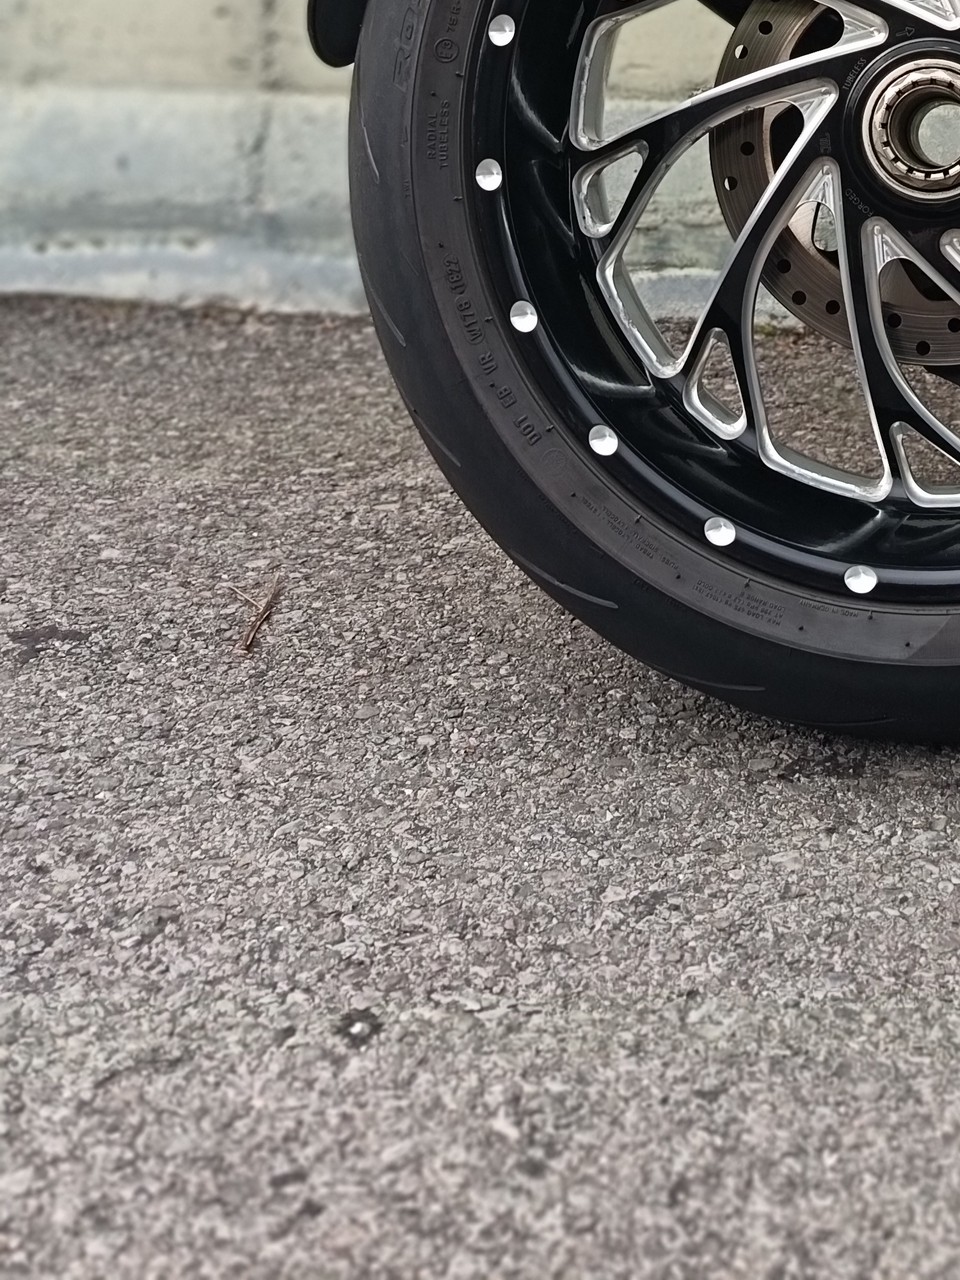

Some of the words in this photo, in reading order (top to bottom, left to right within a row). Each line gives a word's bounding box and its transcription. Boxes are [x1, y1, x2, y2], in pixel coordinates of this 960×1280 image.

[842, 57, 867, 91] TUBELESS
[426, 111, 438, 160] RADIAL
[438, 98, 450, 169] TUBELESS
[845, 188, 874, 218] FORGED
[513, 415, 542, 446] DOT
